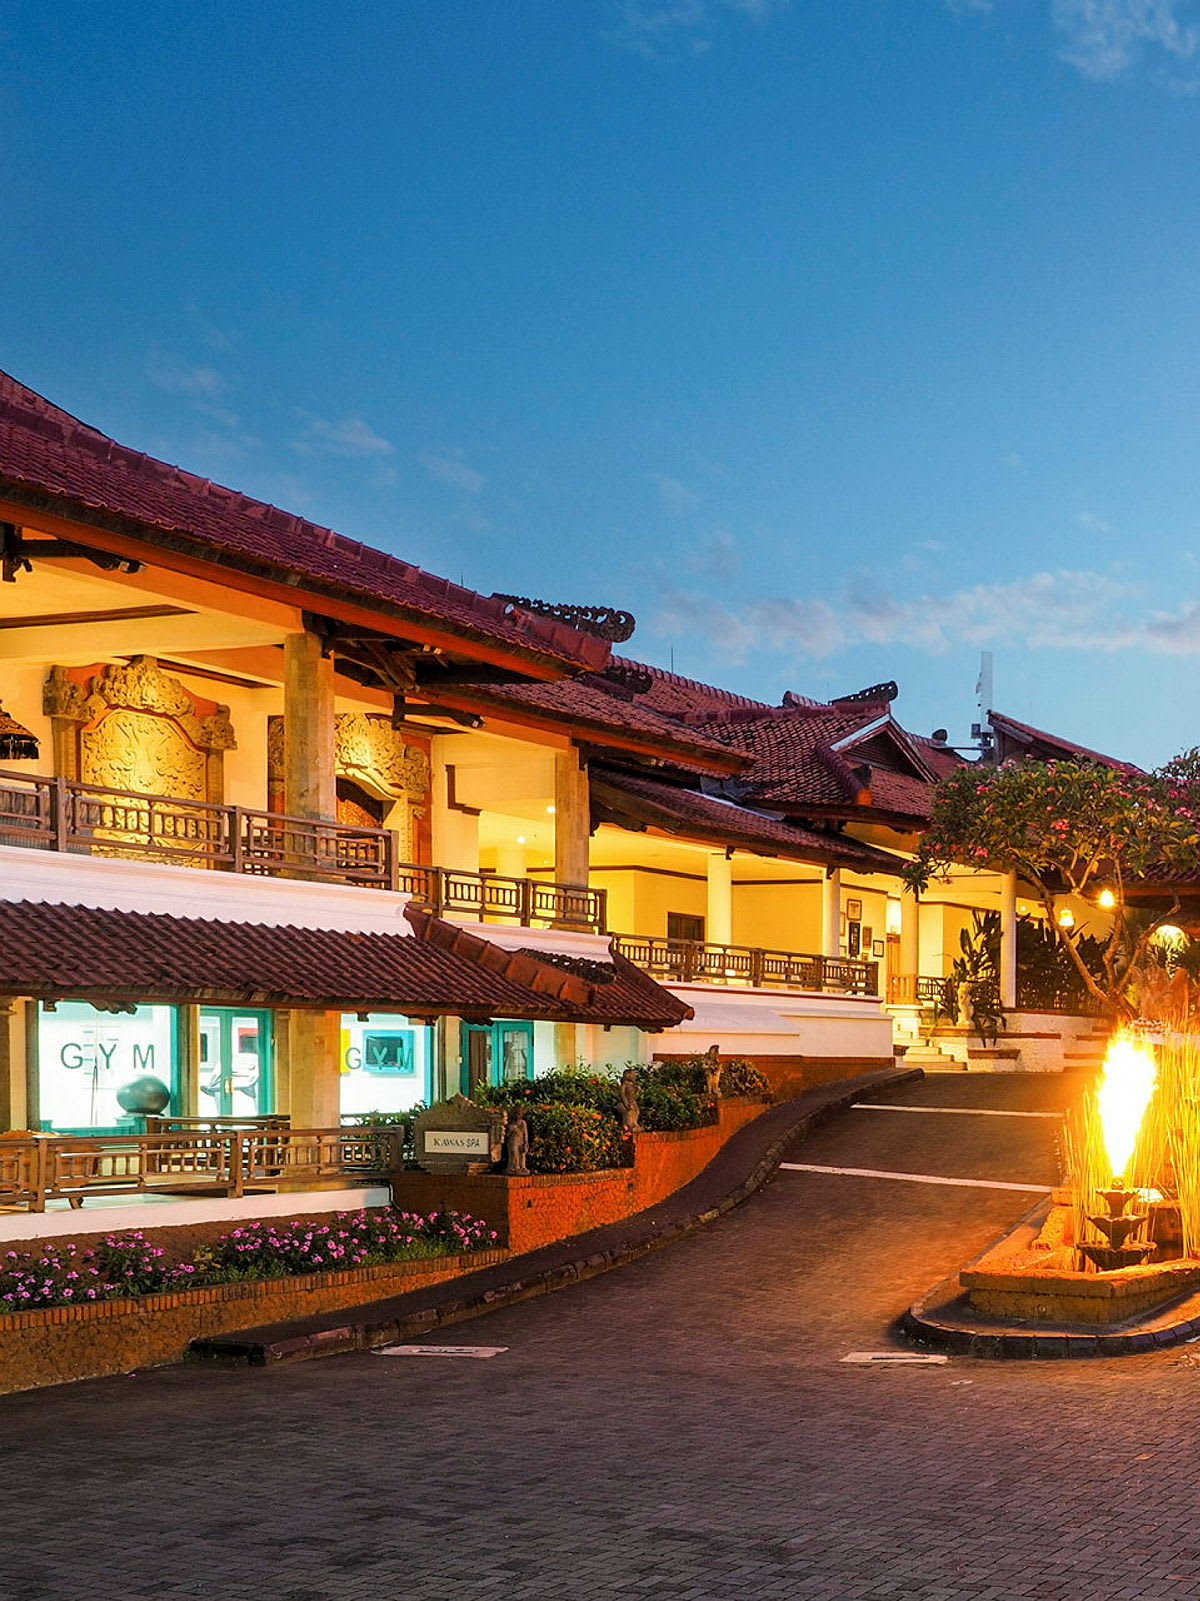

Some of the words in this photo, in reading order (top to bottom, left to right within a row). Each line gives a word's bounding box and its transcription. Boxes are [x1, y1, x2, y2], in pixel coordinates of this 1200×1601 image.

[60, 1042, 154, 1069] GYM
[345, 1047, 414, 1070] GYM
[466, 1138, 481, 1148] SPA
